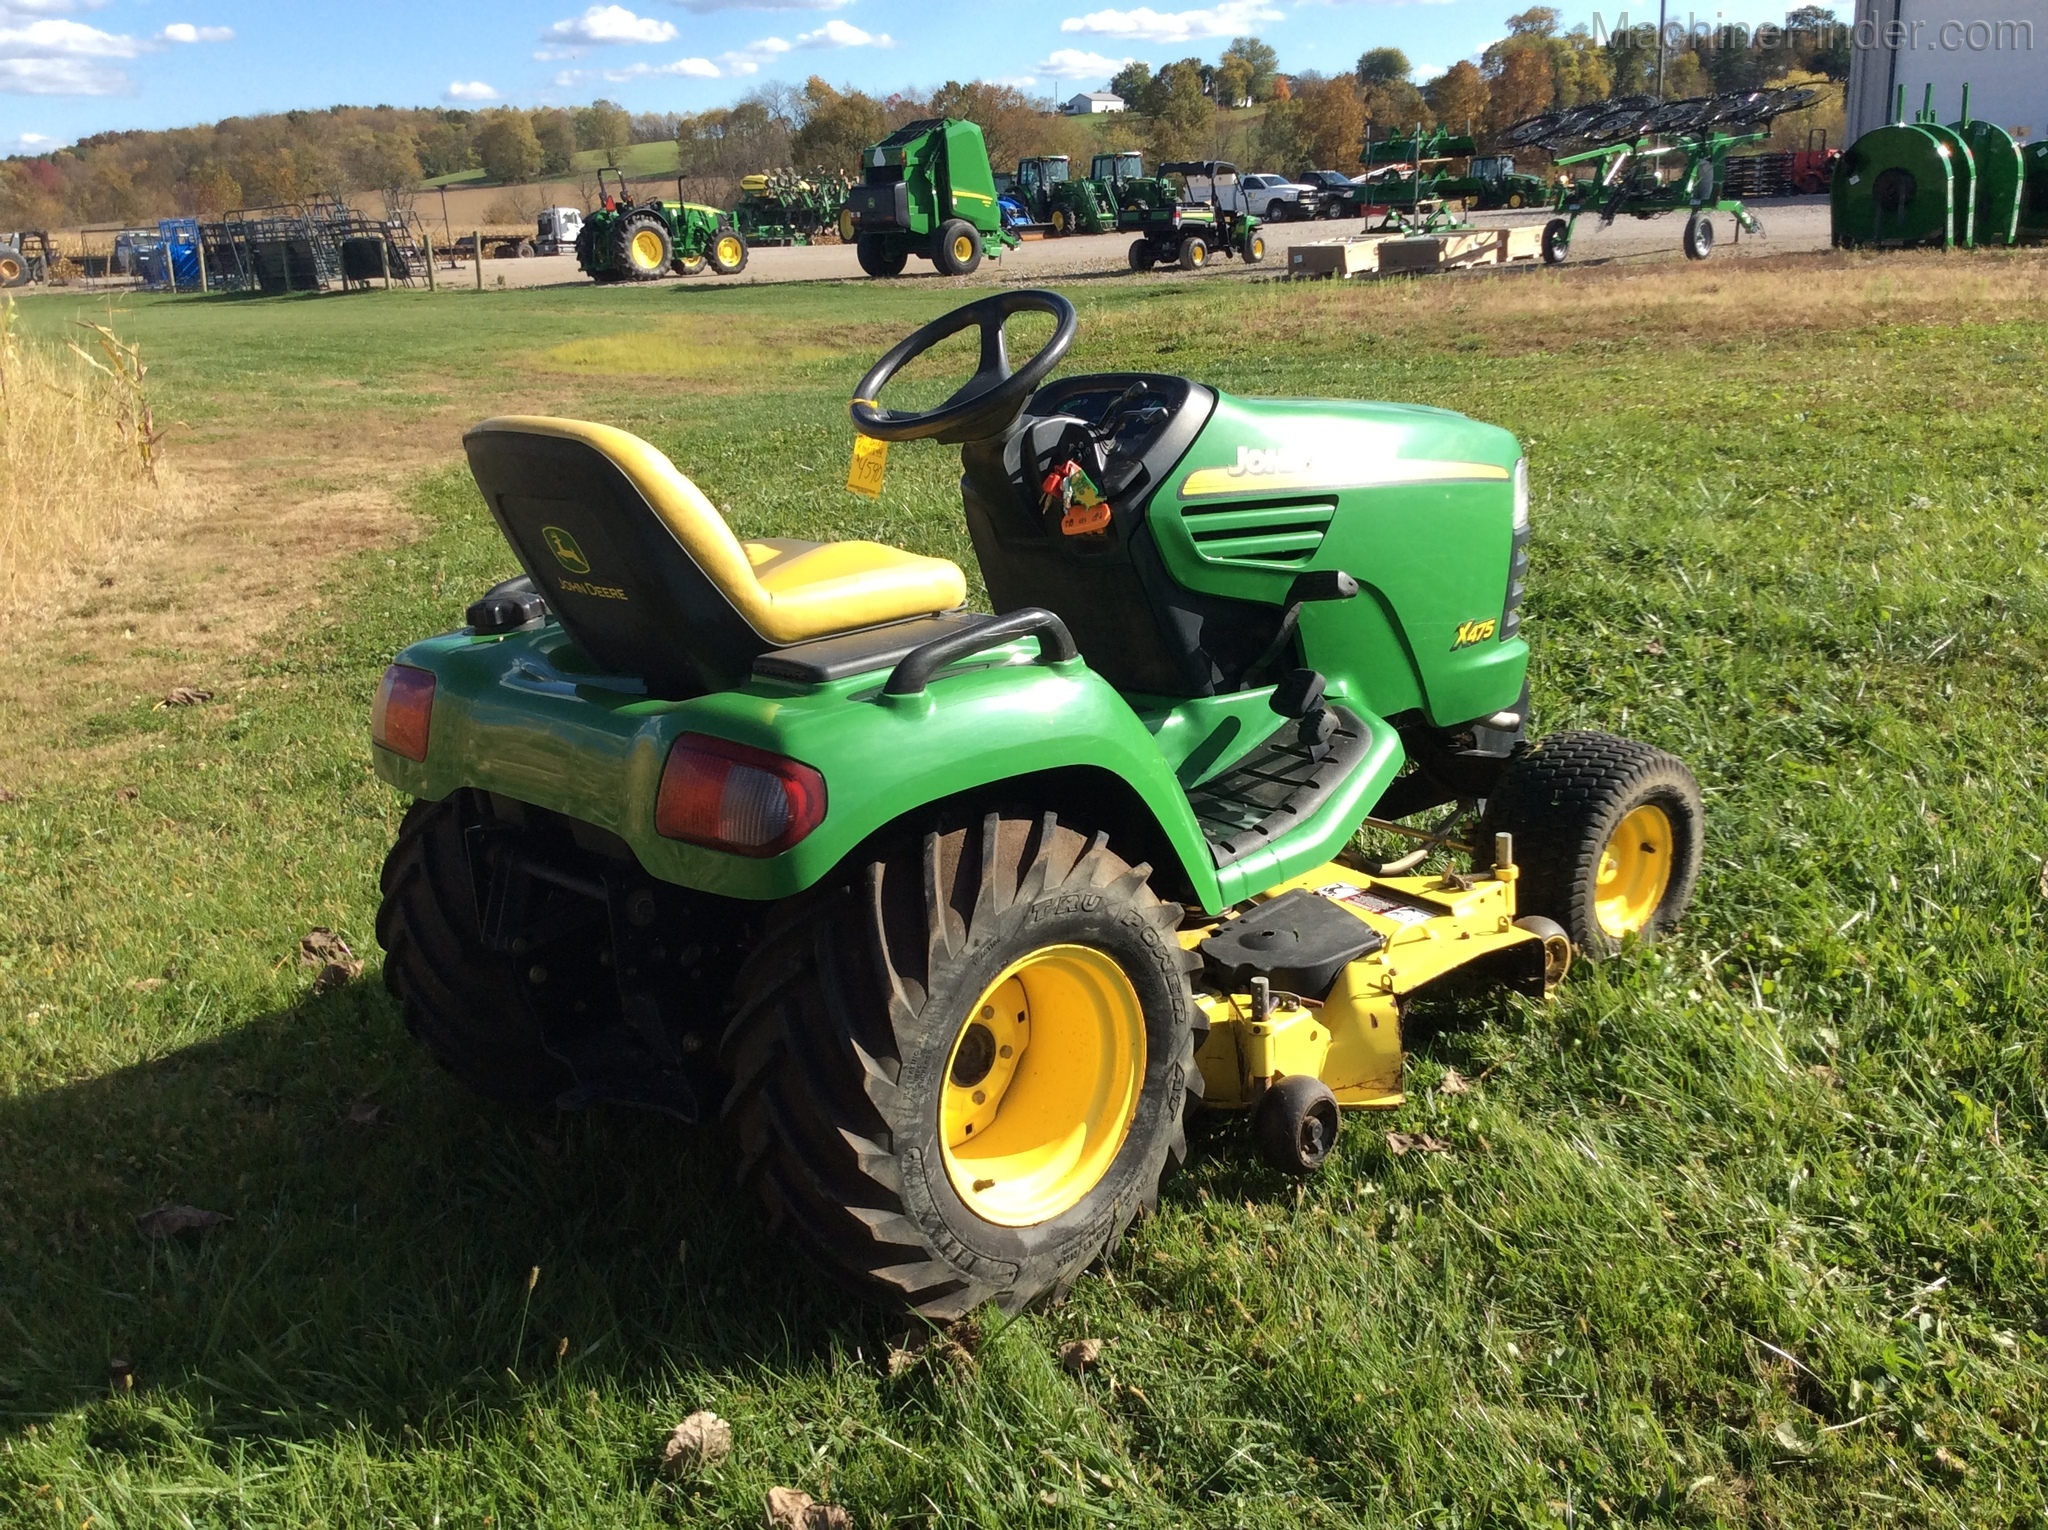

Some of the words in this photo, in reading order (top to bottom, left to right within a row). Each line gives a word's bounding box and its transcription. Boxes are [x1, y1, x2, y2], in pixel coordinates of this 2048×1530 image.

[557, 576, 588, 595] JOHN
[584, 581, 629, 601] DEERE
[1449, 617, 1497, 652] X475
[1031, 894, 1102, 923] TRU
